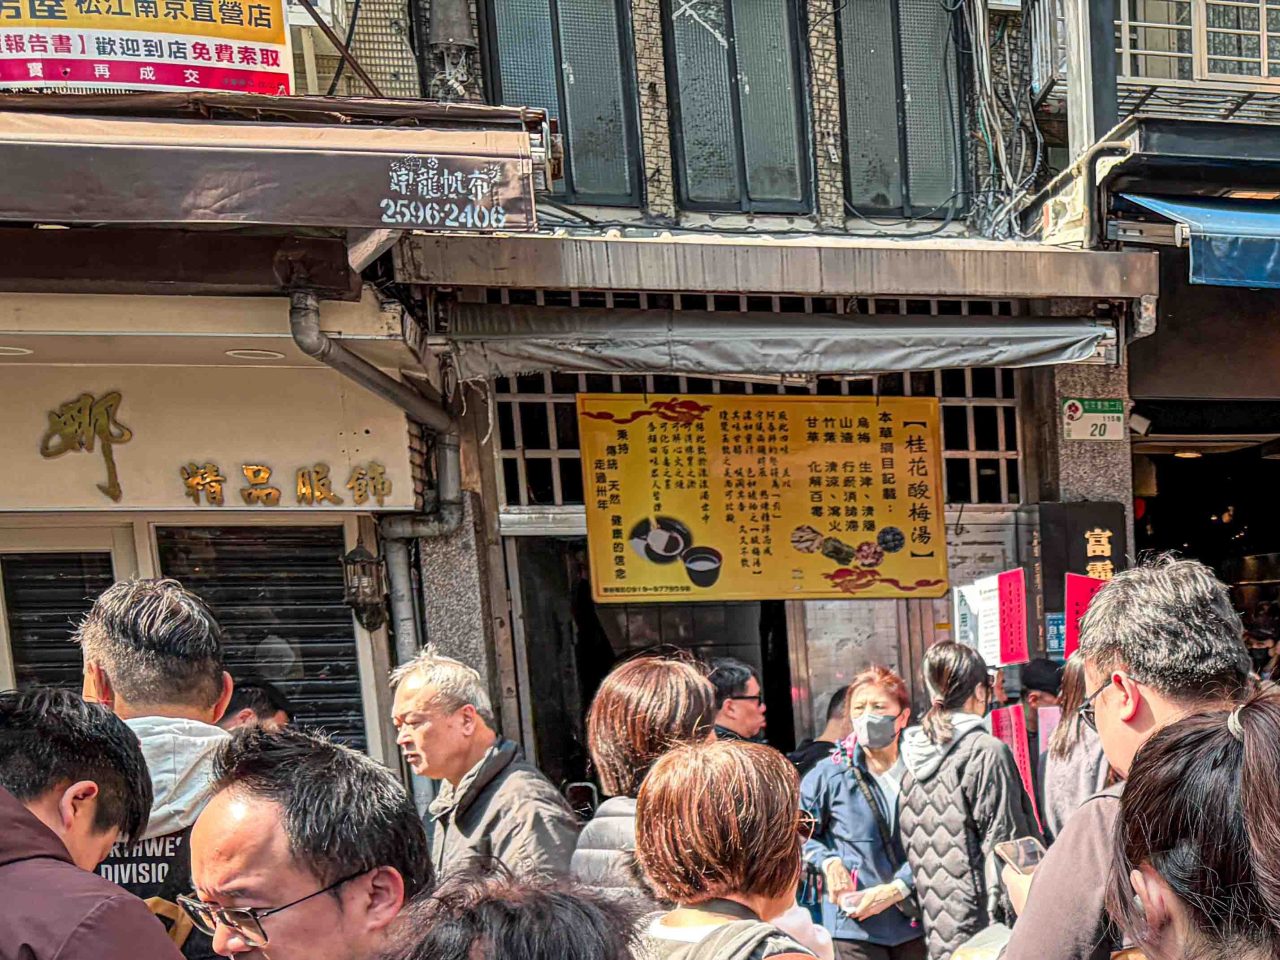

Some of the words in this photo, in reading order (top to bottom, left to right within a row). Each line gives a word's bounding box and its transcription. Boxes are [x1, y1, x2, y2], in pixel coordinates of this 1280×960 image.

[0, 33, 281, 68] 報告書】歡迎到店免費索取
[1090, 423, 1107, 437] 20
[180, 461, 394, 507] 精品服飾
